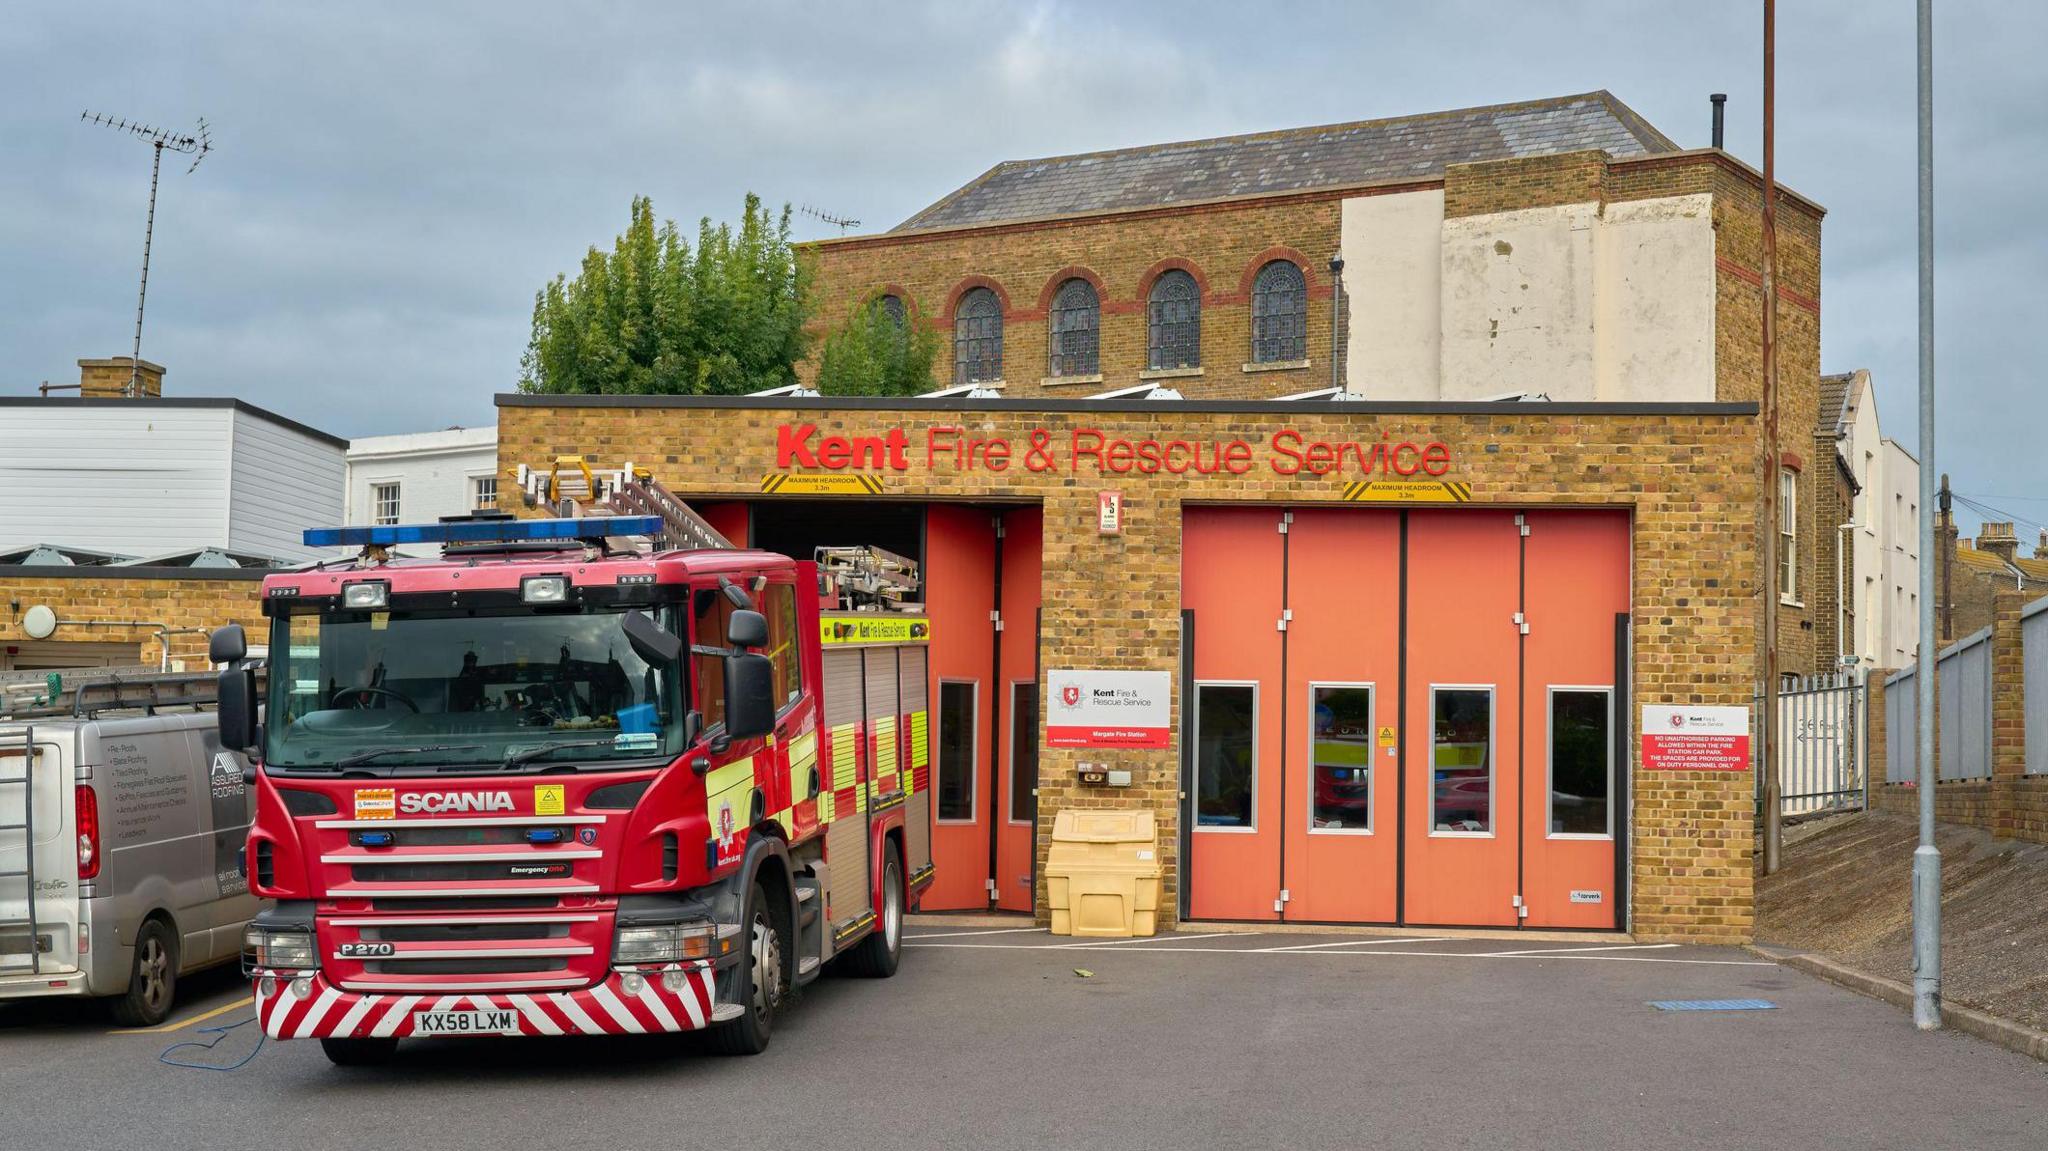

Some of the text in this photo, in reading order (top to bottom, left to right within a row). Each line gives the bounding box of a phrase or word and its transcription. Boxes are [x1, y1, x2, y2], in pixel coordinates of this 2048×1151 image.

[776, 424, 1451, 477] Kent Fire & Rescue Service
[859, 622, 870, 638] Kent
[1093, 689, 1115, 697] Kent
[211, 772, 243, 787] ASSURED
[212, 784, 244, 798] ROOFING
[400, 791, 515, 813] SCANIA
[511, 866, 549, 874] Emergency
[342, 943, 392, 955] P 270
[421, 1012, 511, 1031] KX58 LXM
